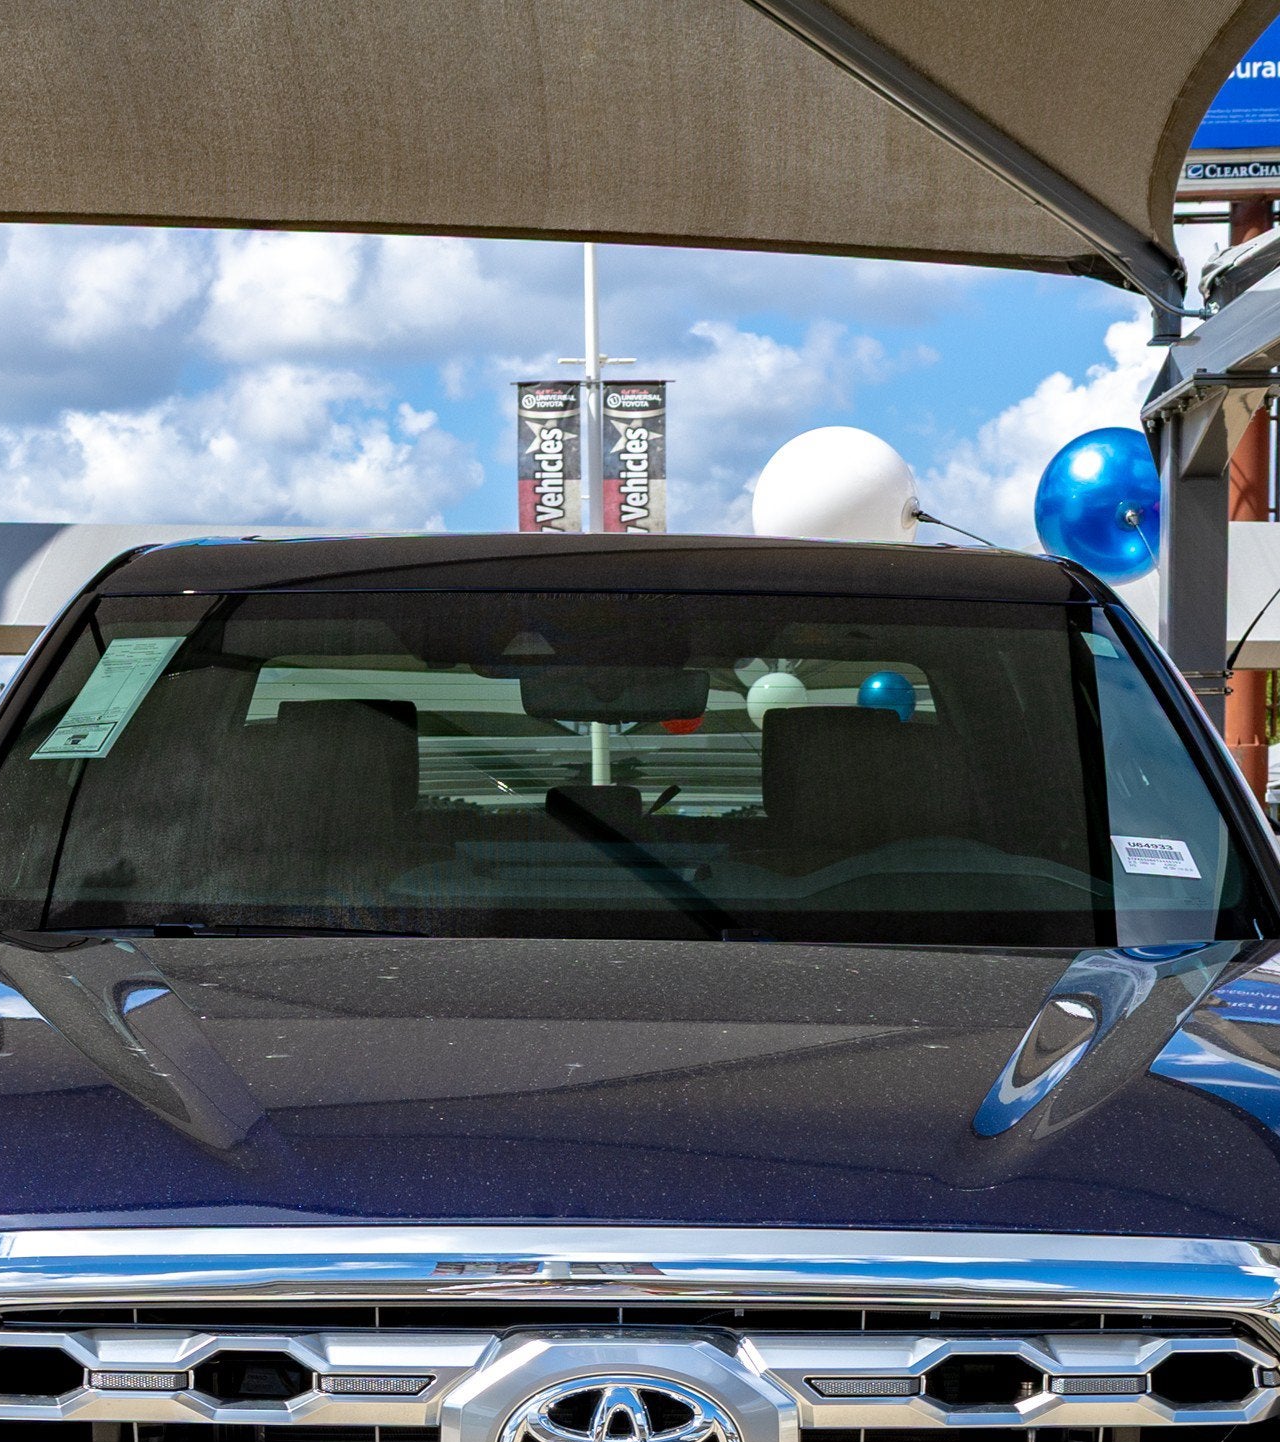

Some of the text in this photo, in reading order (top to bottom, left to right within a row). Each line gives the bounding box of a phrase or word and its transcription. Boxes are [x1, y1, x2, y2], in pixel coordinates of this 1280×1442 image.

[535, 428, 563, 521] Vehicles
[620, 428, 648, 521] Vehicles
[1127, 841, 1174, 851] U64933
